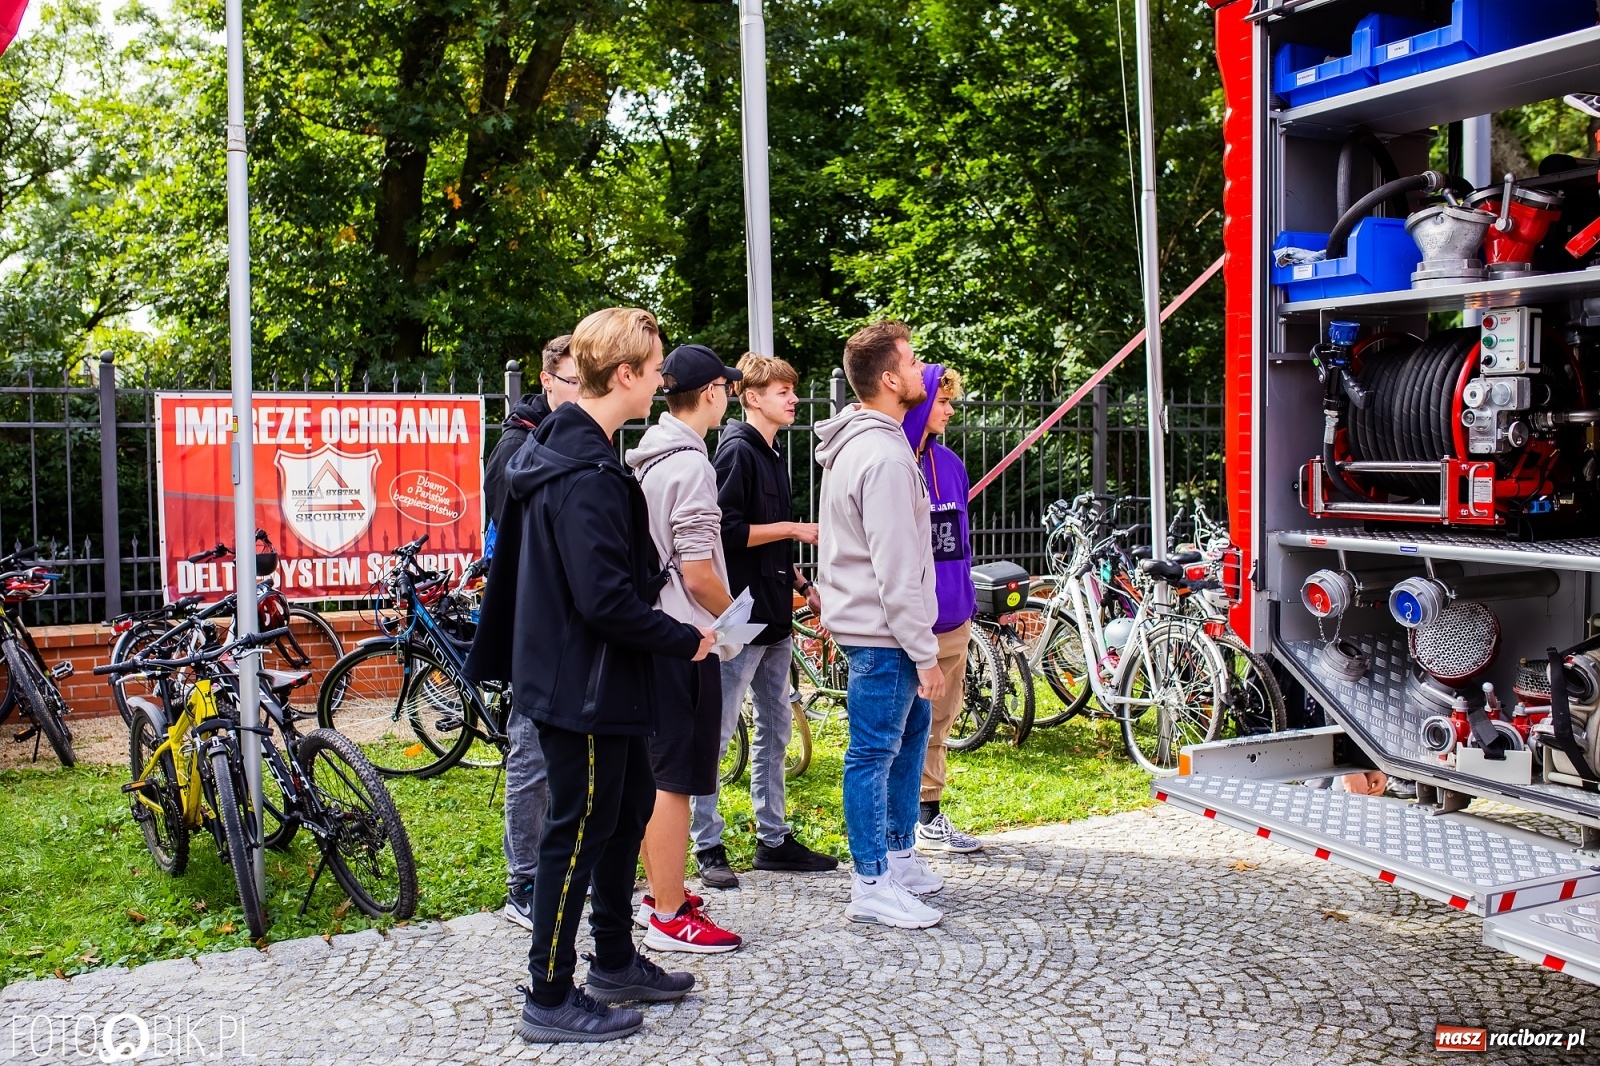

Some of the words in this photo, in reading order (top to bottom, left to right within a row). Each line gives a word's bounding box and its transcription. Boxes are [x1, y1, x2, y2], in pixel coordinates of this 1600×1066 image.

[320, 407, 470, 444] OCHRANIA
[407, 486, 414, 494] o
[415, 485, 450, 506] Państwa
[416, 475, 448, 496] Dbamy
[392, 489, 458, 519] bezpieczeństwo
[937, 502, 957, 511] JAM
[295, 512, 366, 522] SECURITY
[177, 560, 255, 594] DELT
